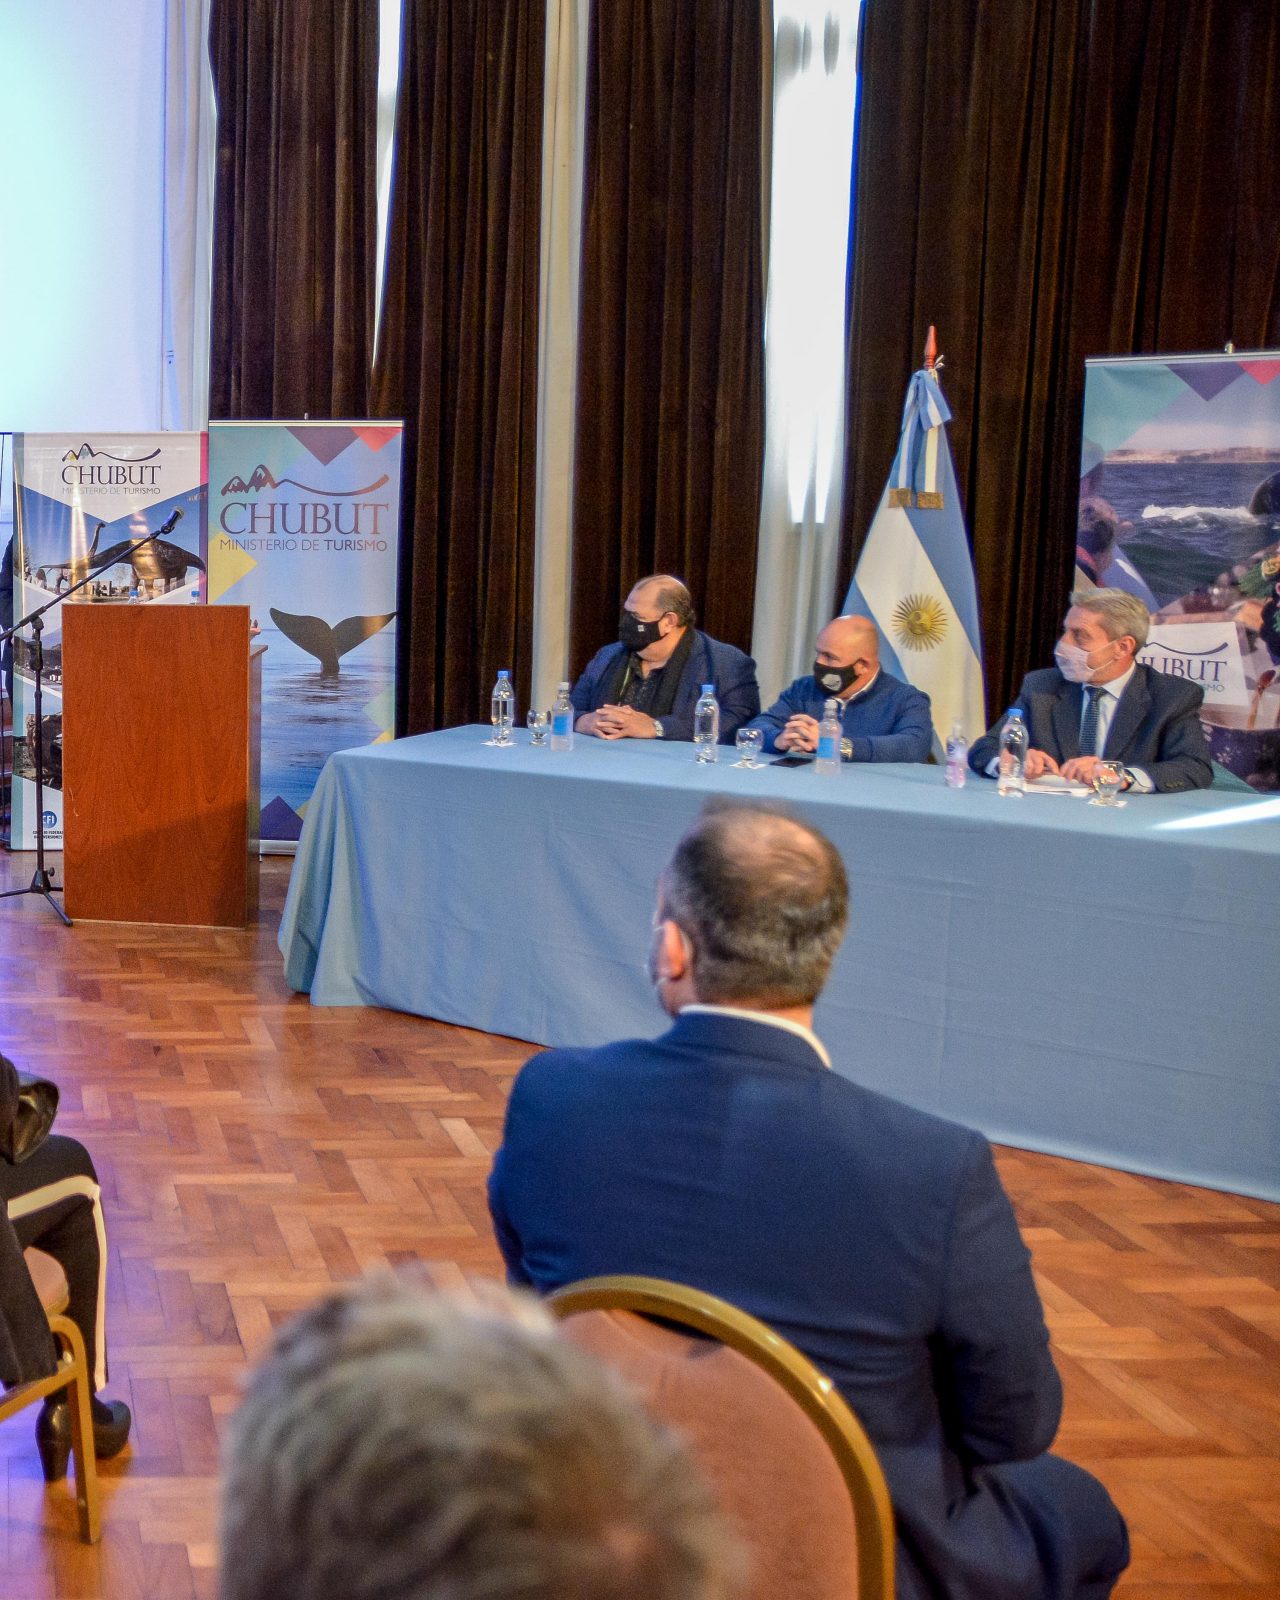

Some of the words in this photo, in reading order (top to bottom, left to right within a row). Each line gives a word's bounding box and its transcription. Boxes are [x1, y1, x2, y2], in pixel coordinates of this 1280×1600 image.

[61, 465, 161, 485] CHUBUT
[110, 487, 120, 495] DE
[123, 487, 161, 495] TURISMO
[220, 502, 389, 535] CHUBUT
[220, 539, 297, 551] MINISTERIO
[302, 539, 319, 551] DE
[324, 539, 387, 552] TURISMO
